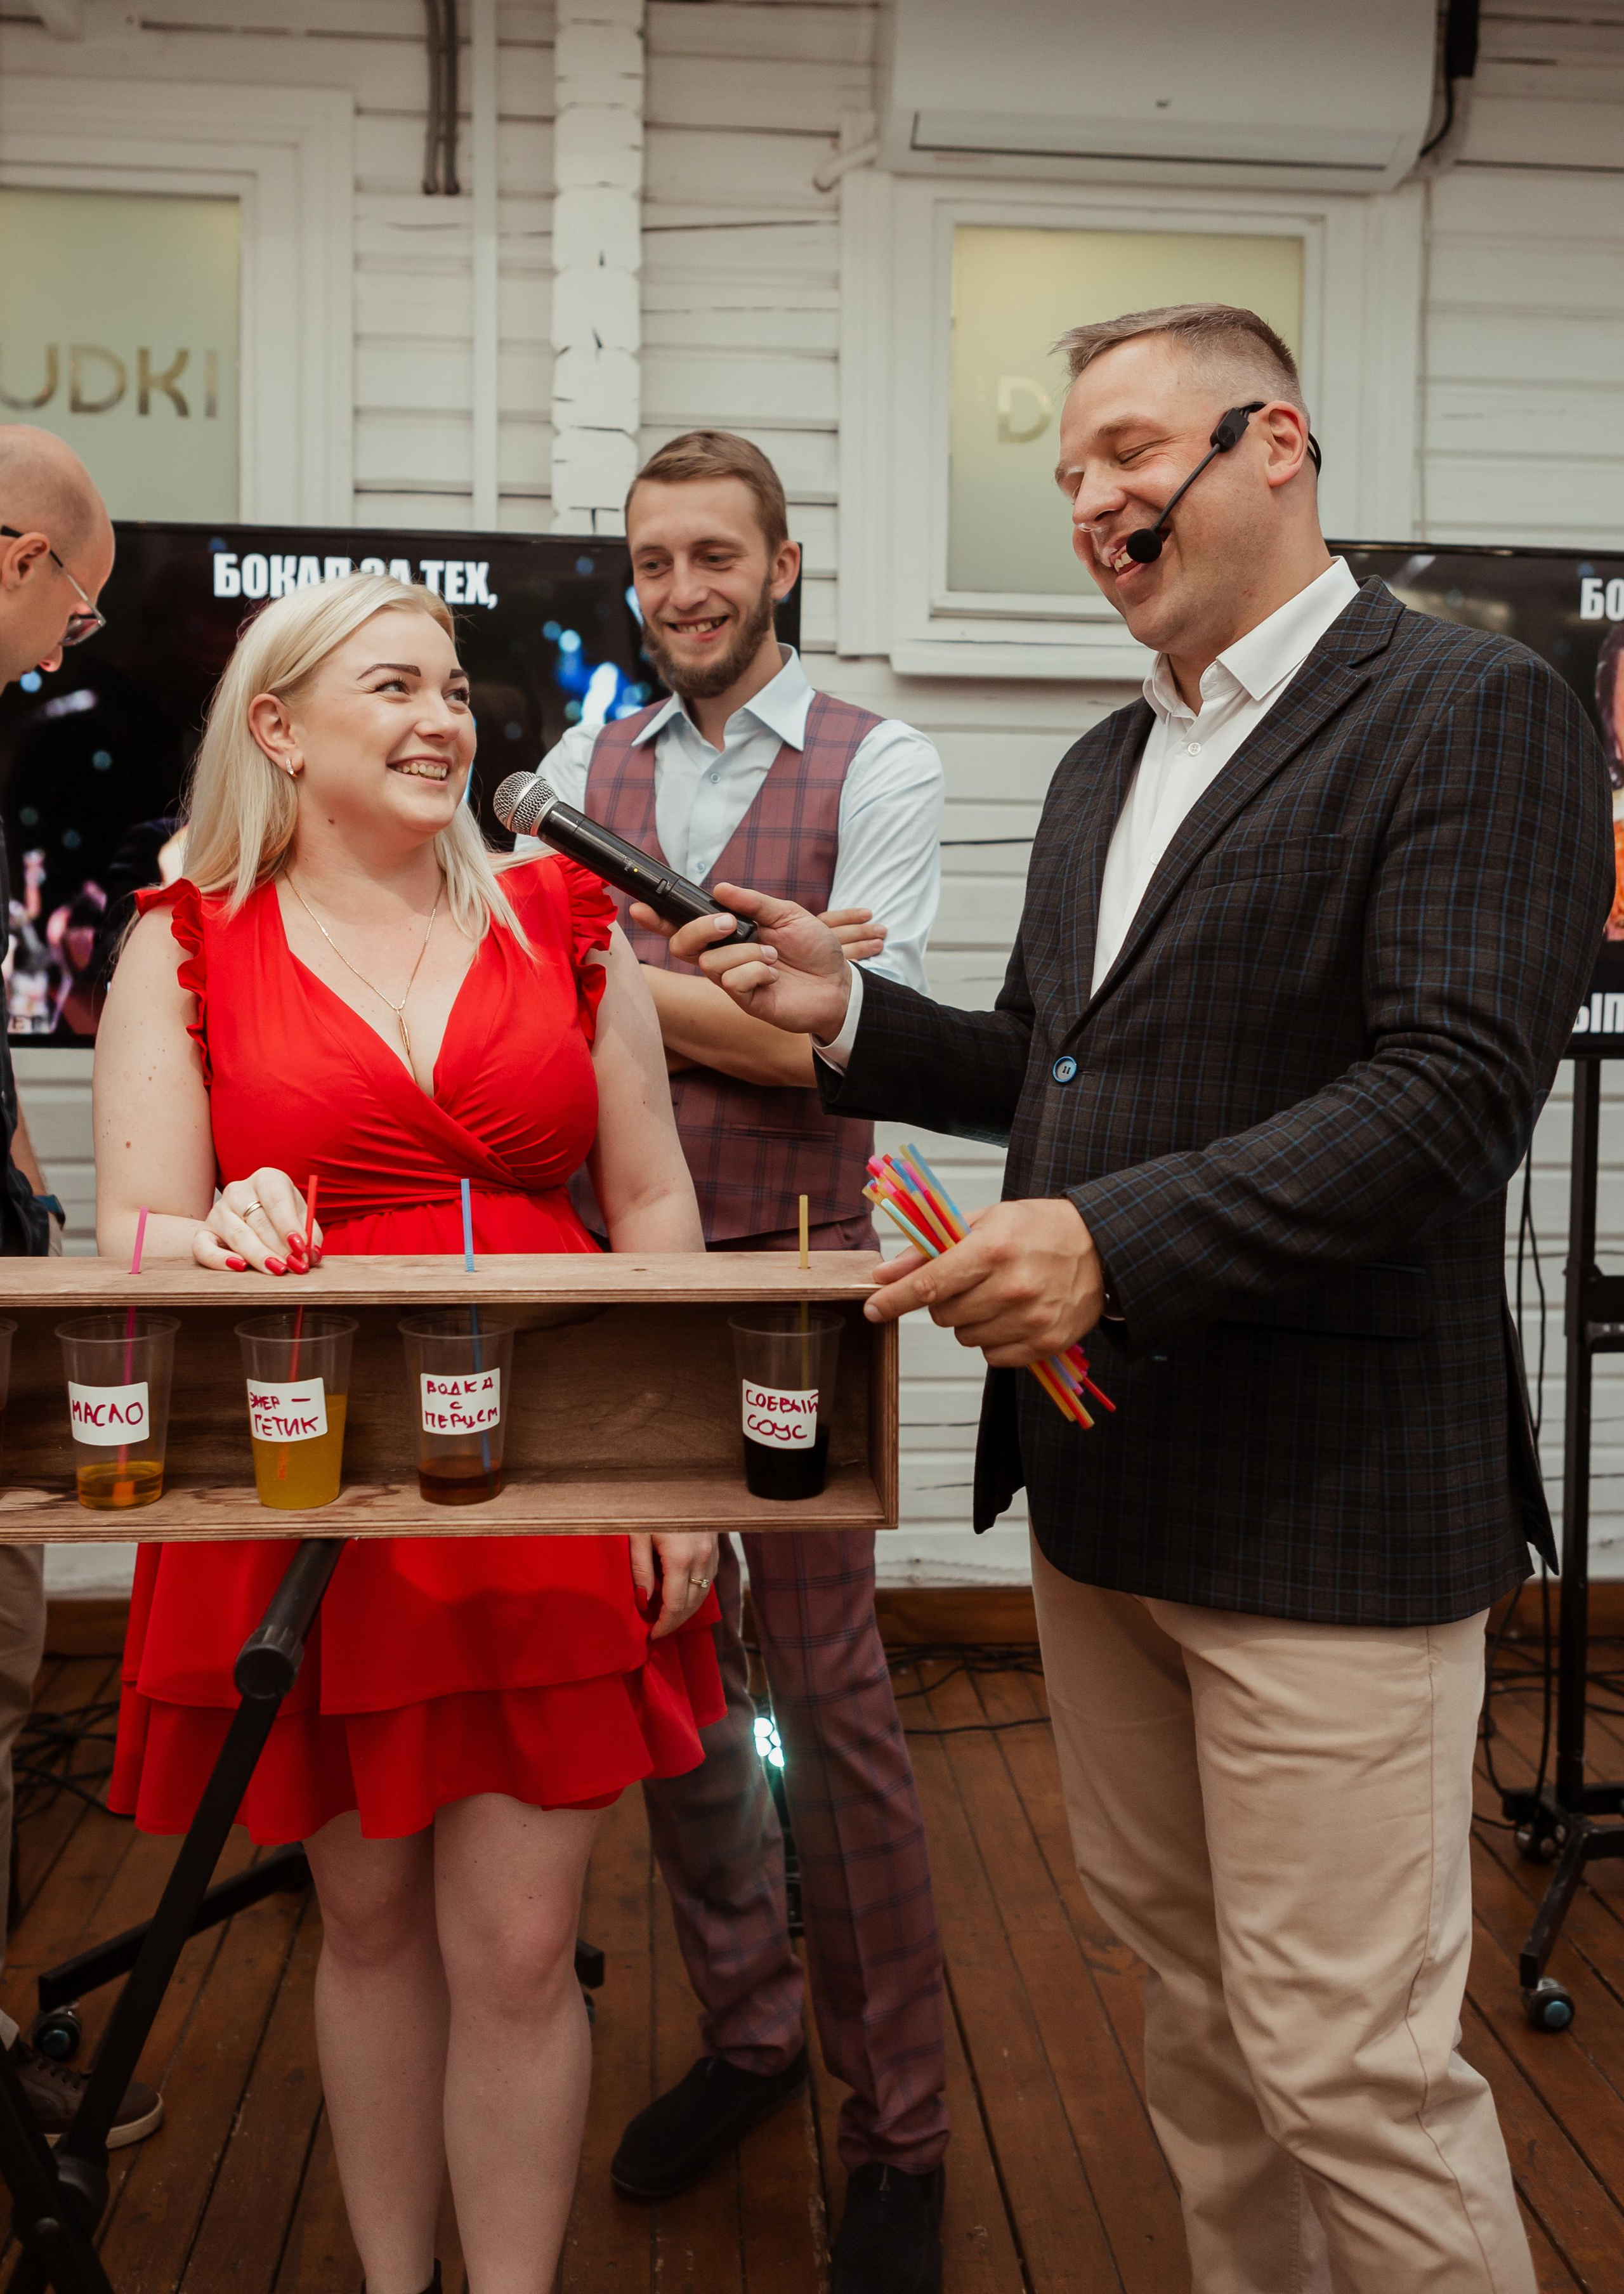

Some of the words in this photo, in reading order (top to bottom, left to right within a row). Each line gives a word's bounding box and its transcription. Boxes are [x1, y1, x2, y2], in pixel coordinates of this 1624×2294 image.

[419, 560, 498, 610] ТЕХ,
[1580, 577, 1624, 621] БО
[427, 1377, 494, 1395] ВОДКА
[72, 1399, 143, 1427] МАСЛО
[746, 1389, 819, 1414] СОЕВЫЙ
[254, 1414, 318, 1436] ГЕТИК
[747, 1414, 807, 1441] СОУС
